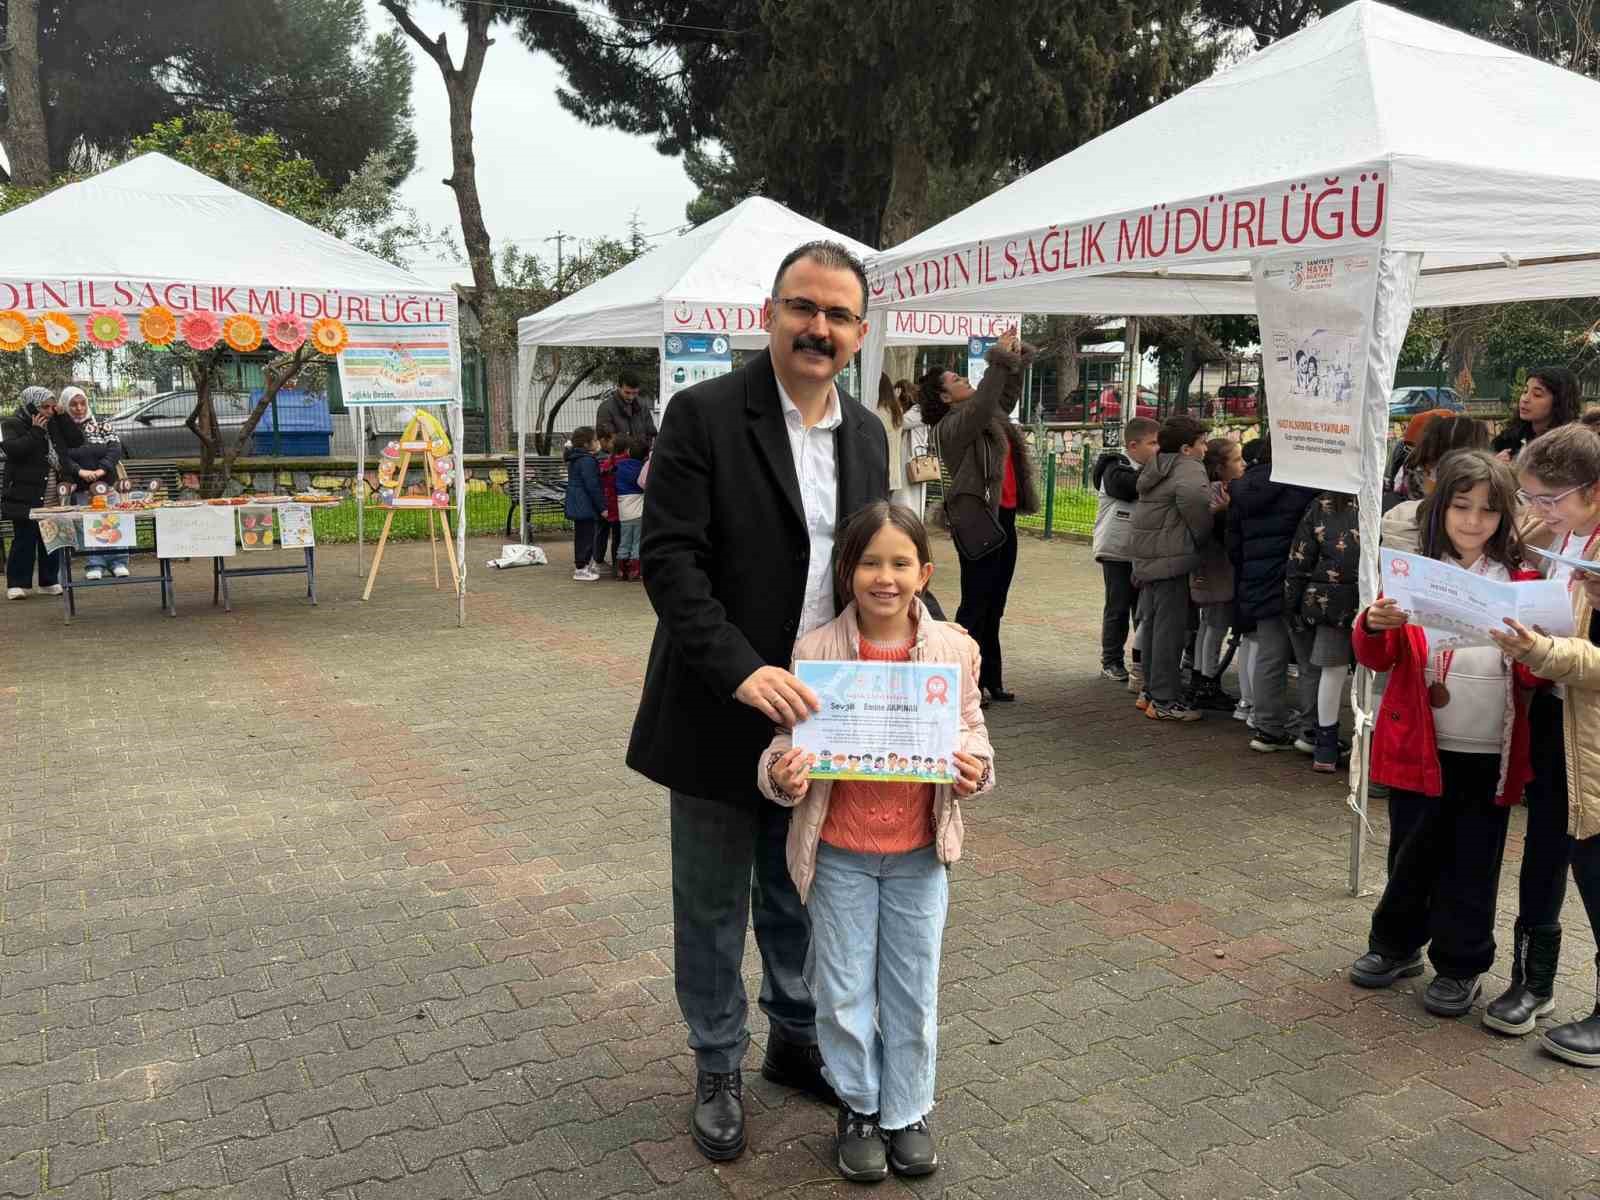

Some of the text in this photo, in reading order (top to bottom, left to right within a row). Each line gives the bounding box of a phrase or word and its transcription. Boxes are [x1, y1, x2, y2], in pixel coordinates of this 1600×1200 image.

[890, 172, 1385, 302] AYDIN İL SAĞLIK MÜDÜRLÜĞÜ
[249, 286, 444, 323] MÜDÜRLÜĞÜ
[700, 307, 768, 330] AYDI
